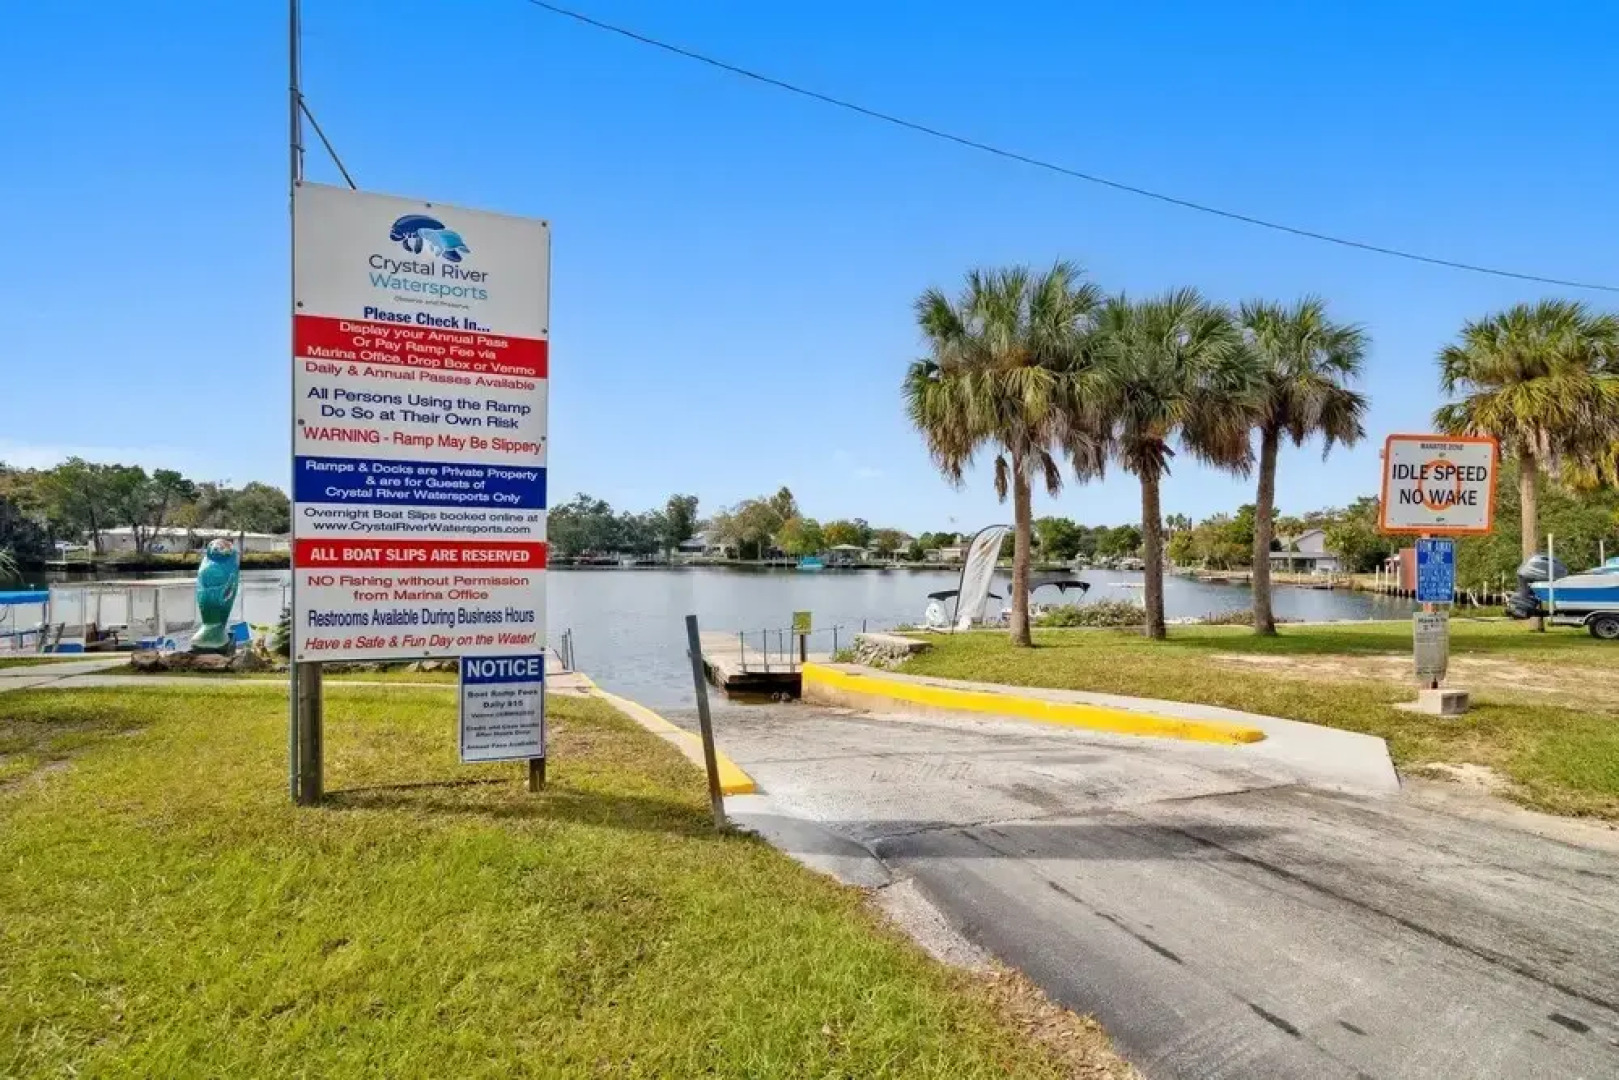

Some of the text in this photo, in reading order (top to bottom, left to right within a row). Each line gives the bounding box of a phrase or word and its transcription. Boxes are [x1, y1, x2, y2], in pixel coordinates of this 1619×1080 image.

[364, 306, 490, 332] Please Check In...
[340, 322, 508, 348] Display your Annual Pass
[353, 337, 496, 360] Or Pay Ramp Fee via
[308, 345, 536, 375] Marina Office, Drop Box or Venmo
[306, 362, 535, 391] Daily & Annual Passes Available
[308, 387, 531, 416] All Persons Using the Ramp
[322, 405, 518, 429] Do So at Their Own Risk
[304, 427, 380, 443] WARNING
[393, 433, 434, 448] Ramp
[438, 435, 465, 451] May
[470, 437, 487, 449] Be
[492, 438, 541, 455] Slippery
[306, 460, 537, 481] Ramps & Docks are Private Property
[1392, 464, 1487, 481] IDLE SPEED
[366, 476, 485, 488] & are for Guests of
[325, 487, 521, 504] Crystal River Watersports Only
[1400, 489, 1477, 505] NO WAKE
[304, 508, 537, 522] Overnight Boat Slips booked online at
[314, 521, 530, 535] www.CrystalRiverWatersports.com
[311, 548, 529, 562] ALL BOAT SLIPS ARE RESERVED
[308, 576, 529, 587] NO Fishing without Permission
[353, 590, 488, 600] from Marina Office
[309, 607, 534, 628] Restrooms Available During Business Hours
[305, 632, 536, 650] Have a Safe & Fun Day on the Water!
[467, 659, 539, 677] NOTICE
